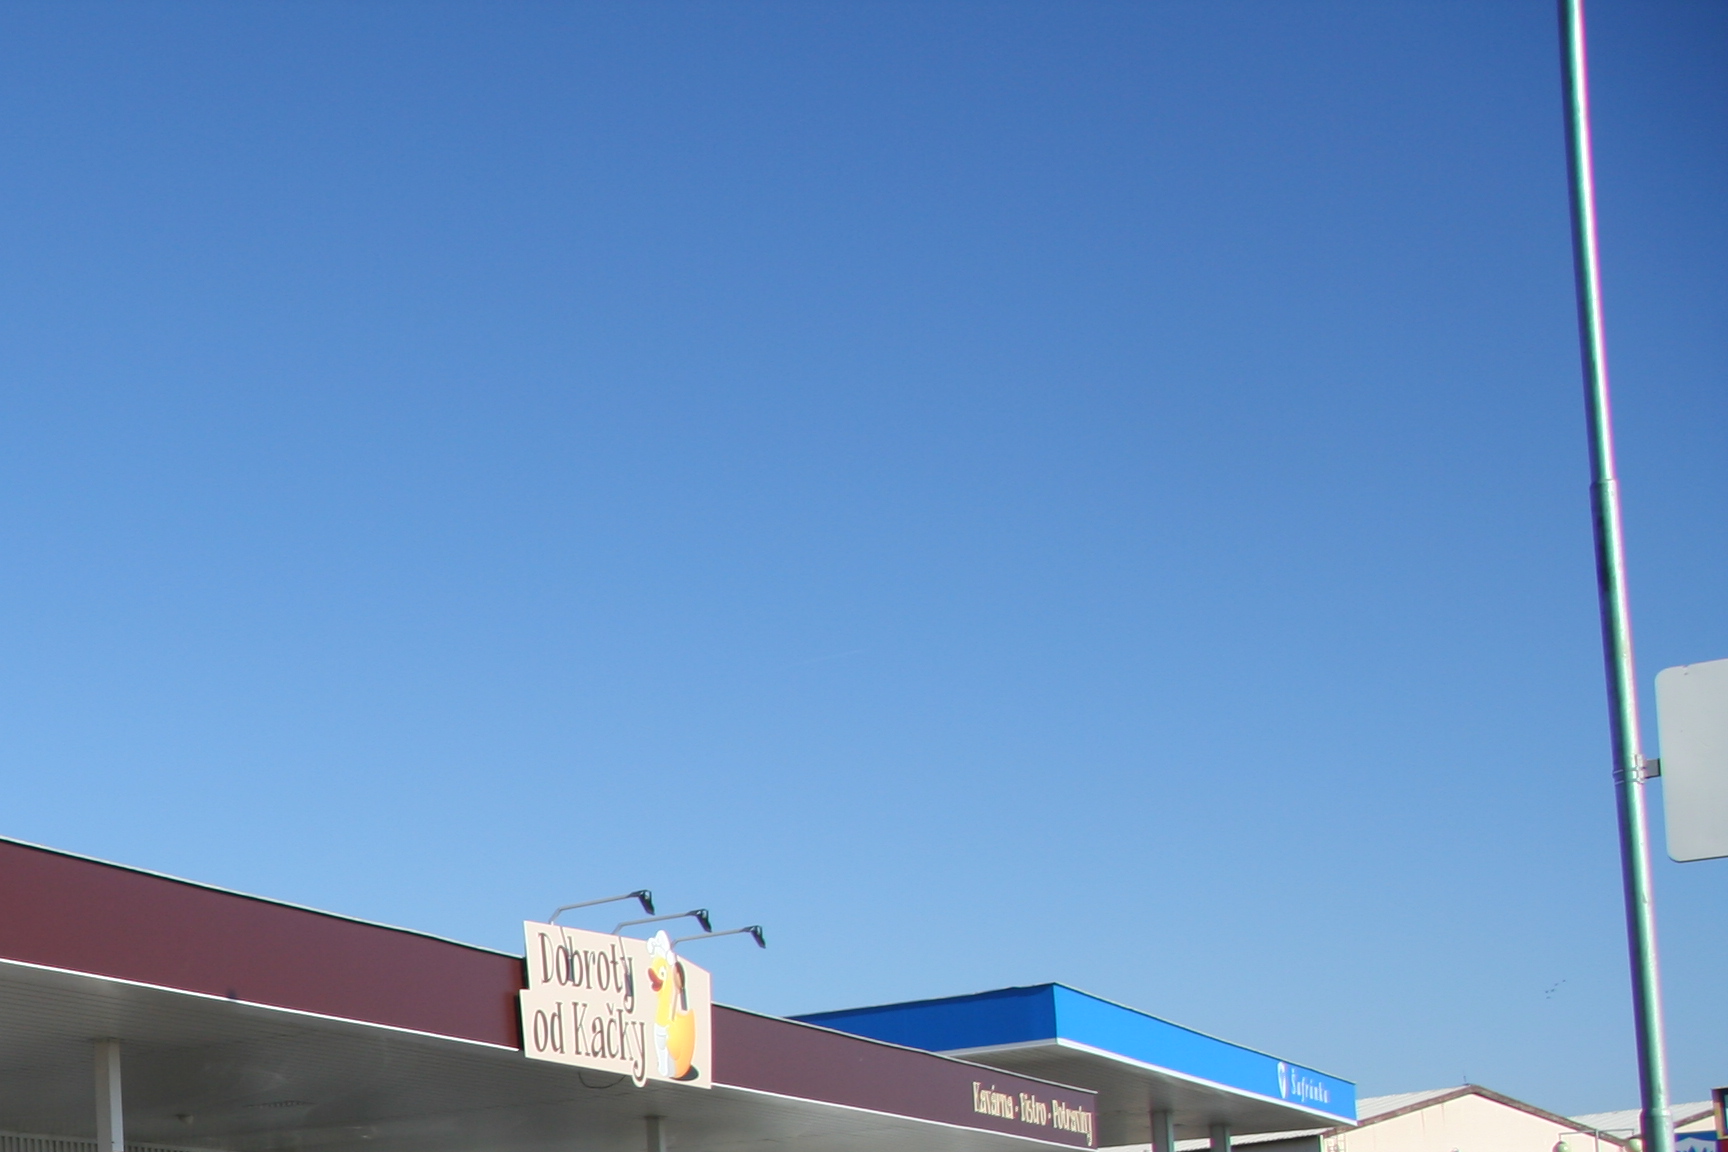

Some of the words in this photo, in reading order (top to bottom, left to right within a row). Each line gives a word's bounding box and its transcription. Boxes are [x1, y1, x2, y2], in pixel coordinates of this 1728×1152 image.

[538, 932, 635, 1014] Dobroty
[533, 1001, 564, 1054] od
[572, 1001, 646, 1082] Kačky
[972, 1081, 1015, 1120] Kavárna
[1019, 1092, 1047, 1126] Bistro
[1051, 1099, 1093, 1147] Potraviny
